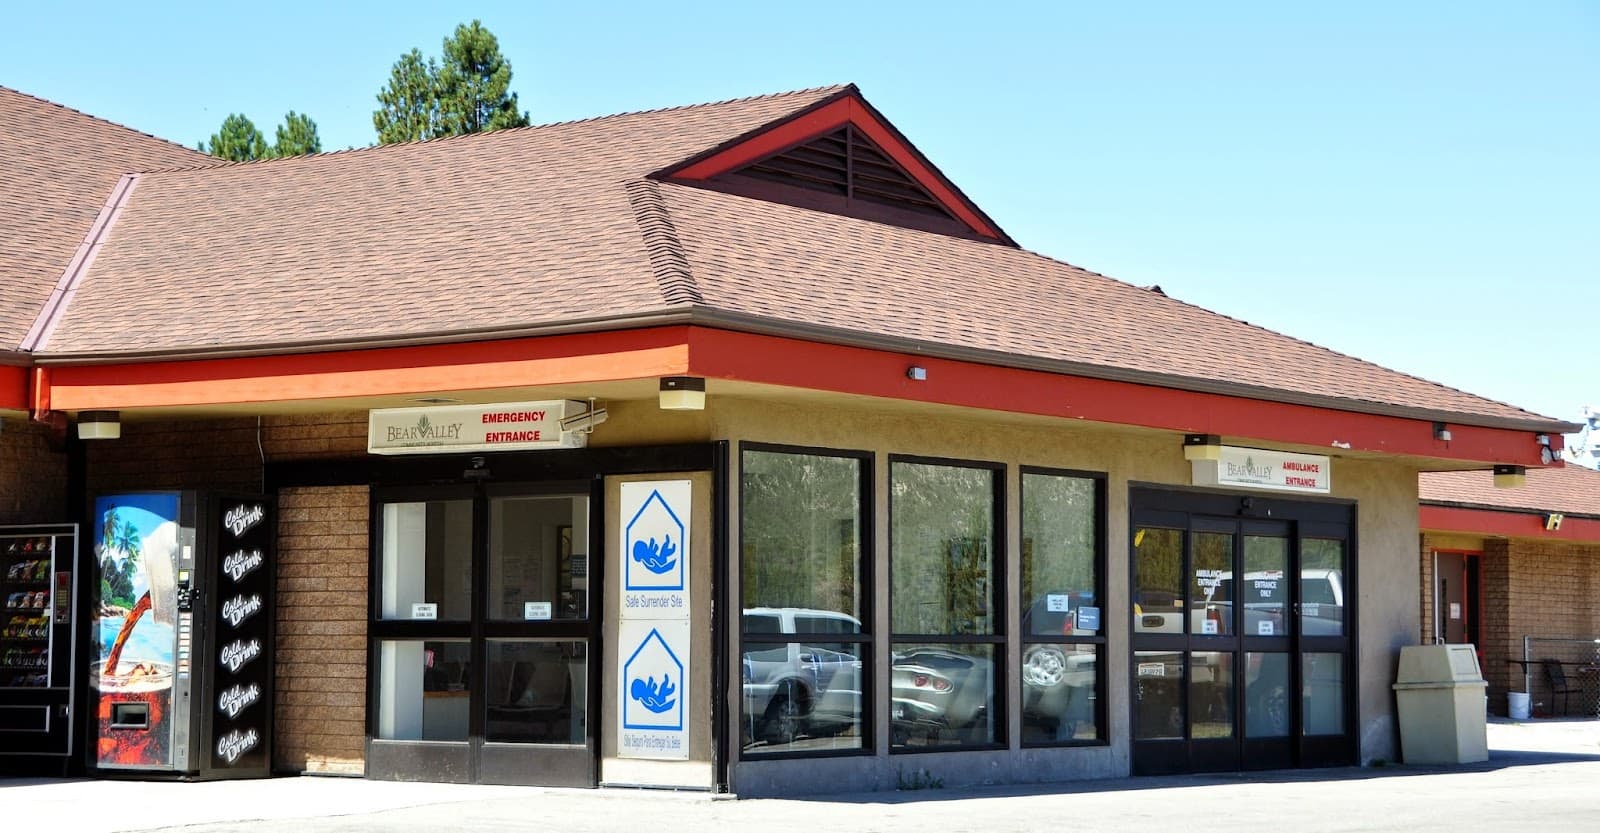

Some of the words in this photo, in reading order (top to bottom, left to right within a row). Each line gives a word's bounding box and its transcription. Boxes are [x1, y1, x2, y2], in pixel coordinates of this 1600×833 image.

[482, 411, 546, 424] EMERGENCY
[486, 430, 541, 442] ENTRANCE
[1282, 461, 1320, 473] AMBULANCE
[1285, 476, 1316, 488] ENTRANCE
[225, 504, 244, 529] Cold
[233, 505, 263, 537] Drink
[223, 549, 243, 574] Cold
[232, 550, 262, 582] Drink
[1254, 581, 1277, 589] ENTRANCE
[1260, 589, 1272, 598] ONLY
[222, 594, 242, 619] Cold
[231, 595, 261, 627] Drink
[625, 594, 640, 608] Safe
[640, 594, 669, 608] Surrender
[670, 594, 683, 608] Site
[221, 639, 241, 665] Cold
[230, 639, 260, 672] Drink
[219, 684, 240, 710] Cold
[228, 684, 259, 717] Drink
[218, 729, 239, 755] Cold
[227, 730, 257, 762] Drink
